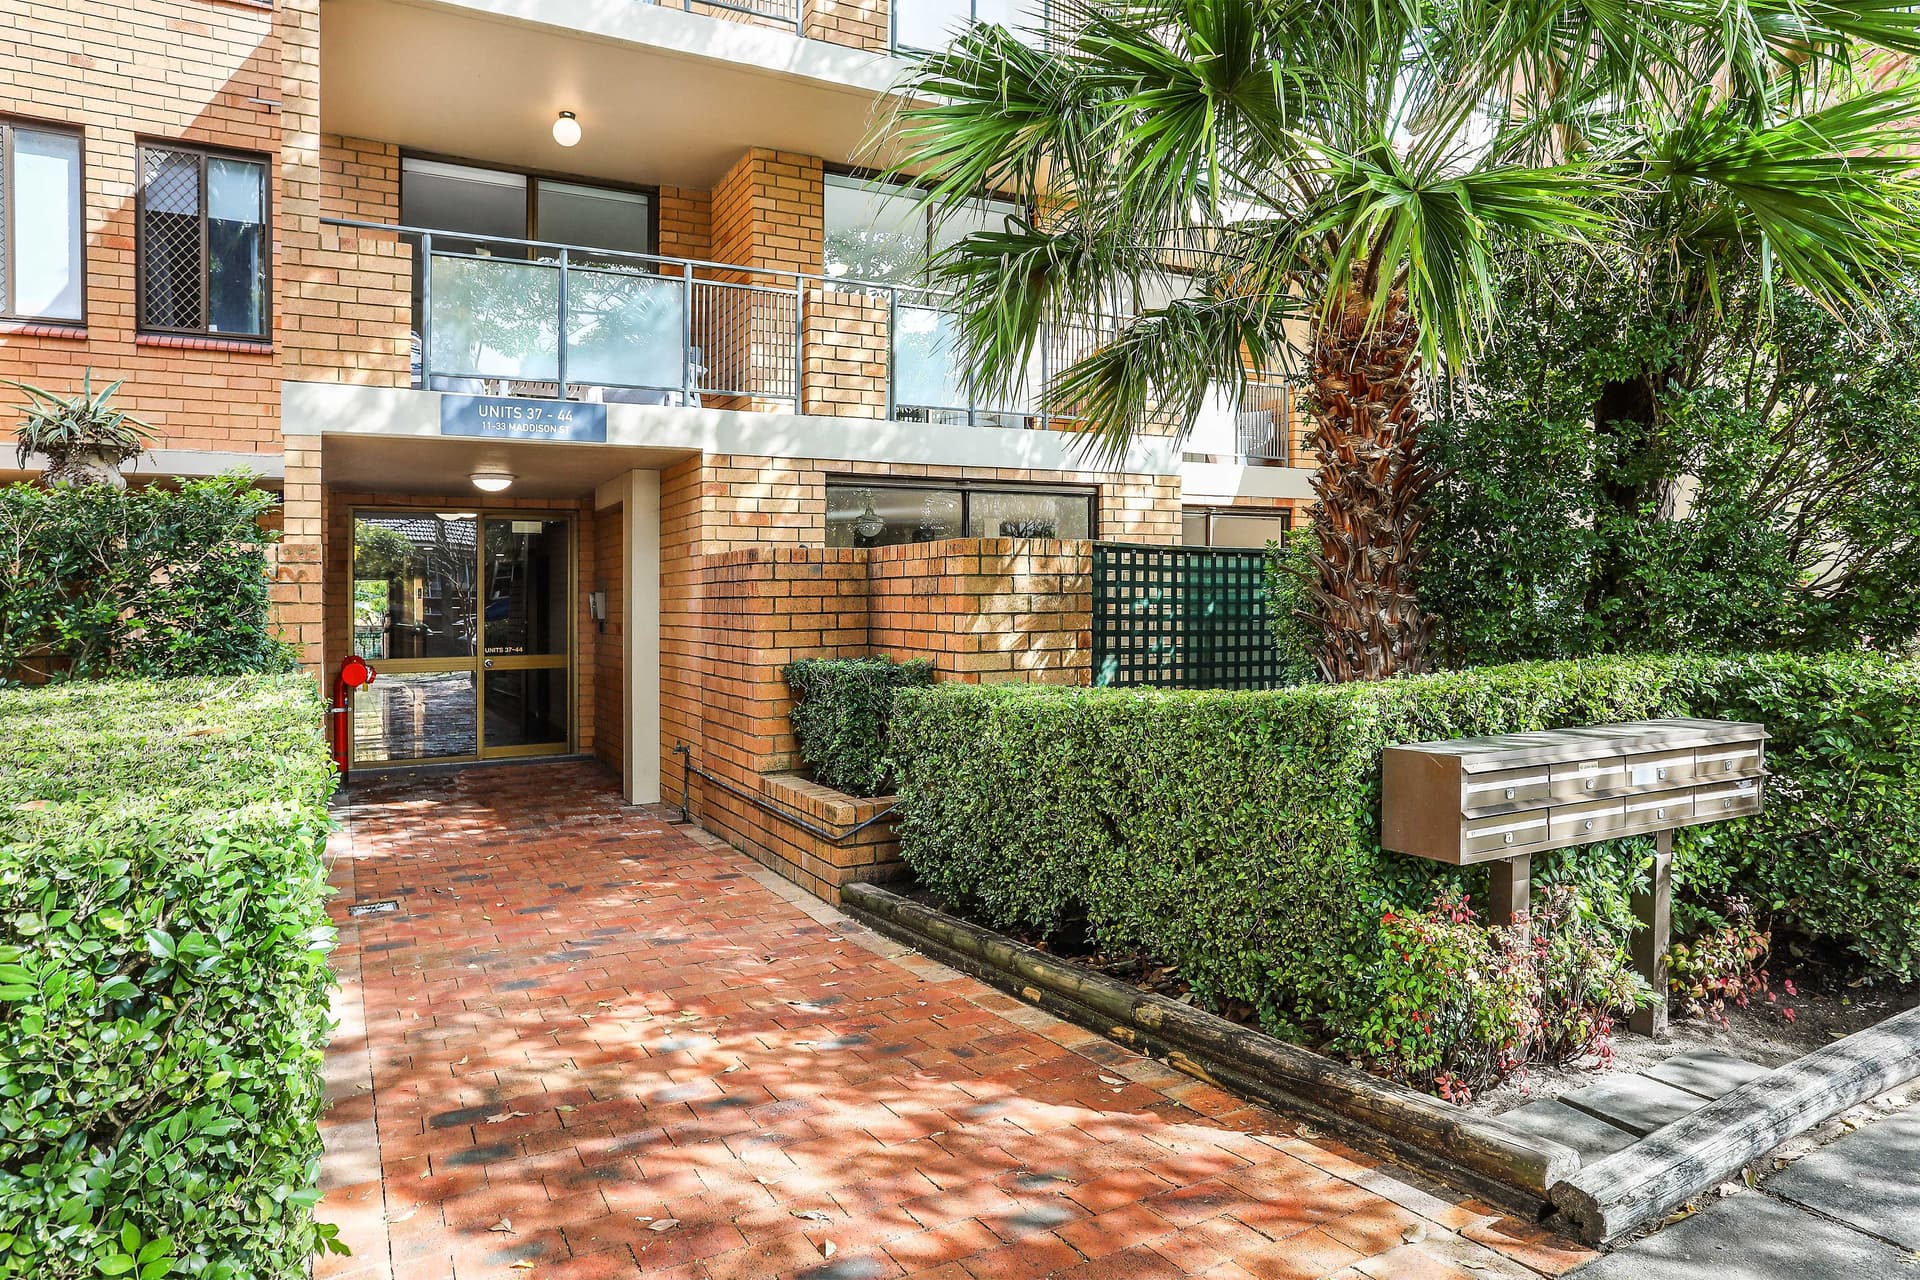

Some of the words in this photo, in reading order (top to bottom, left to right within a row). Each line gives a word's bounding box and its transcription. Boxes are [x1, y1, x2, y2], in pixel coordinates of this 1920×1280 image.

[479, 405, 522, 419] UNITS
[527, 408, 542, 420] 37
[557, 410, 573, 422] 44
[482, 421, 506, 431] 11-33
[508, 423, 556, 433] MADDISON
[558, 426, 570, 434] ST
